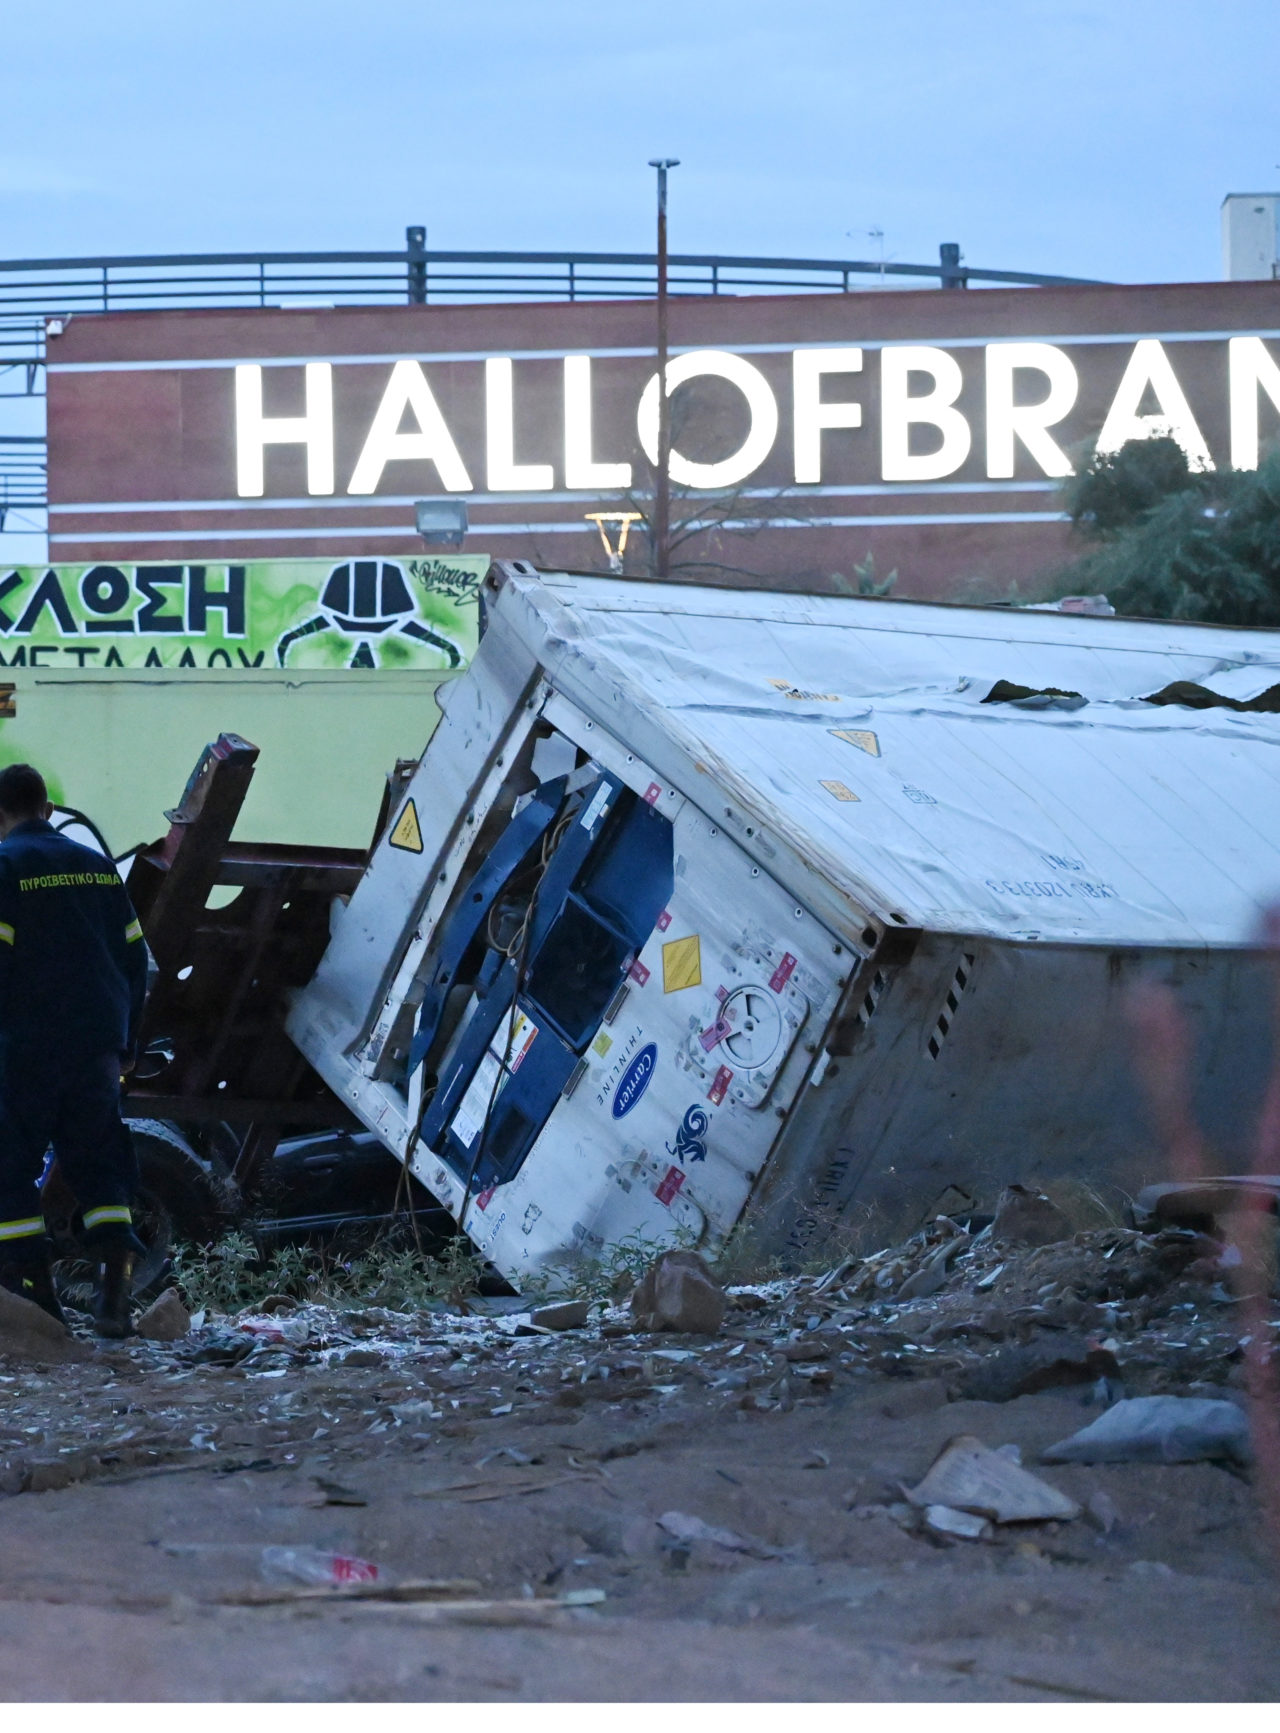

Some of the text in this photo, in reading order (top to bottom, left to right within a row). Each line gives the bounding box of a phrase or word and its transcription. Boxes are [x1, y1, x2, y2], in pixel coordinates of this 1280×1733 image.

[20, 872, 121, 892] ΠΥΡΟΣΒΕΣΤΙΚΟ ΣΩΜΑ
[597, 1026, 643, 1106] THINLINE
[619, 1053, 652, 1111] Carrier
